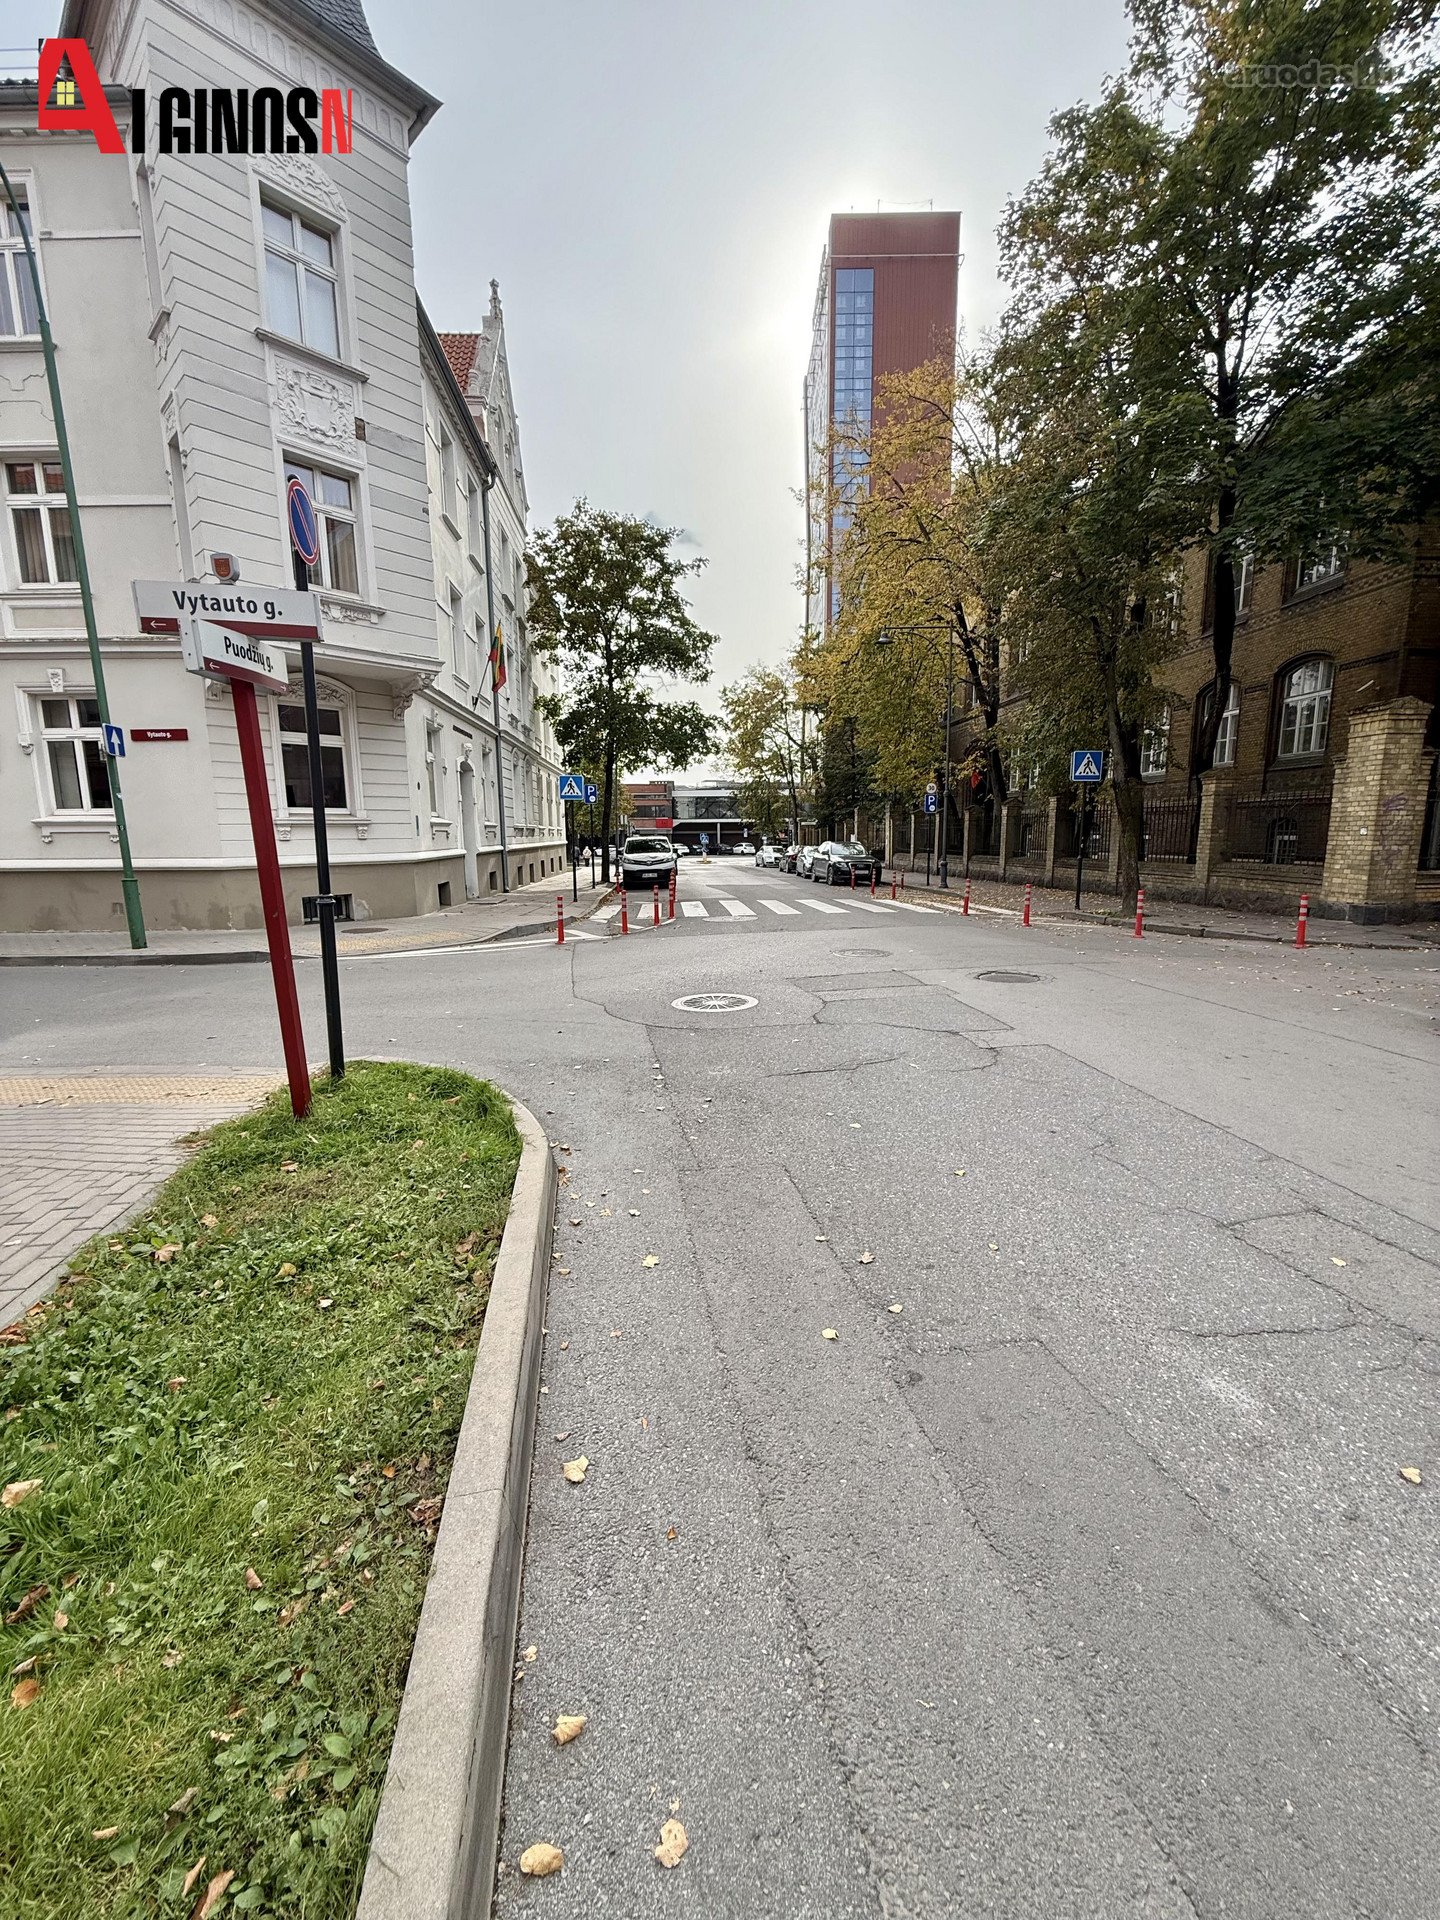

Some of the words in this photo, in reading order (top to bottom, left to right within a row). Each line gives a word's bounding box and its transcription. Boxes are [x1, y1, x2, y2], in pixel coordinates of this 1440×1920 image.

[172, 590, 258, 616] Vytauto
[263, 600, 283, 620] g.
[224, 635, 266, 671] Puodžių
[266, 656, 274, 673] g.
[146, 731, 166, 739] Vytauto
[587, 785, 595, 796] P
[928, 795, 935, 805] P
